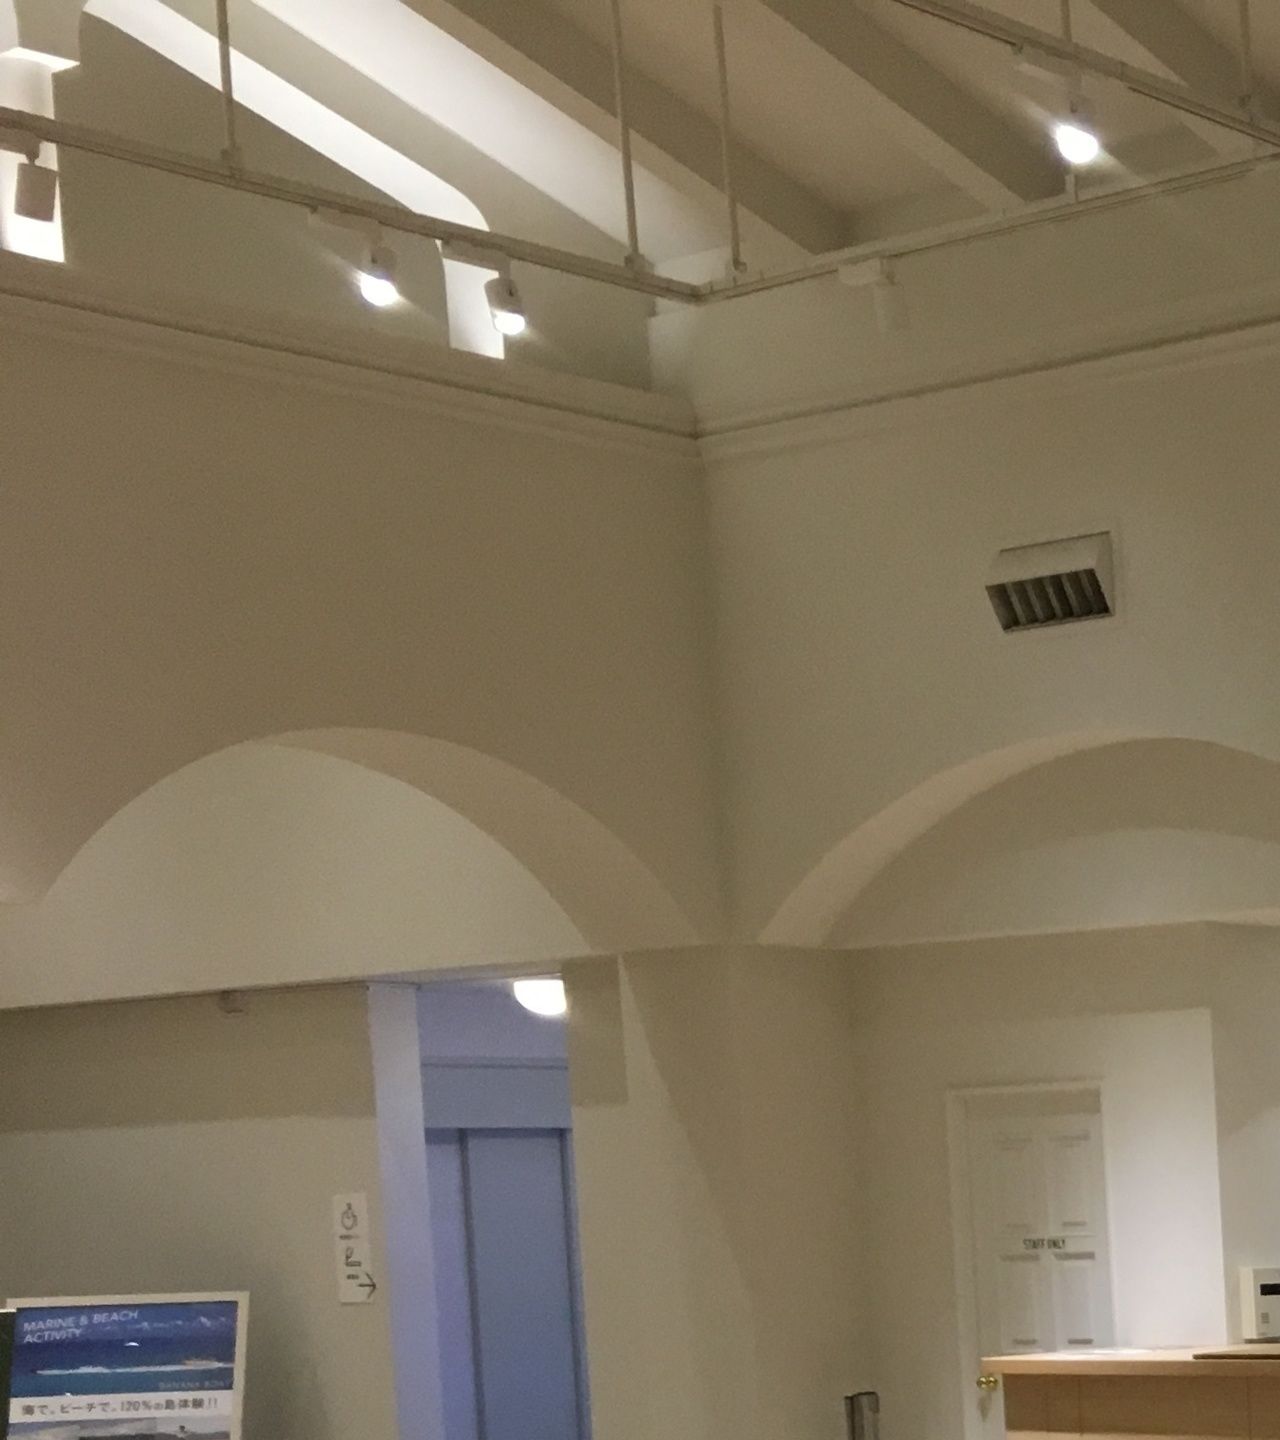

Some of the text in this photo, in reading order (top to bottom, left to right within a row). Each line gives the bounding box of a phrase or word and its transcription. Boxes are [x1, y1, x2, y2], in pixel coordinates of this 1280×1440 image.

[23, 1316, 79, 1332] MARINE
[92, 1310, 139, 1324] BEACH
[23, 1327, 83, 1344] ACTIVITY
